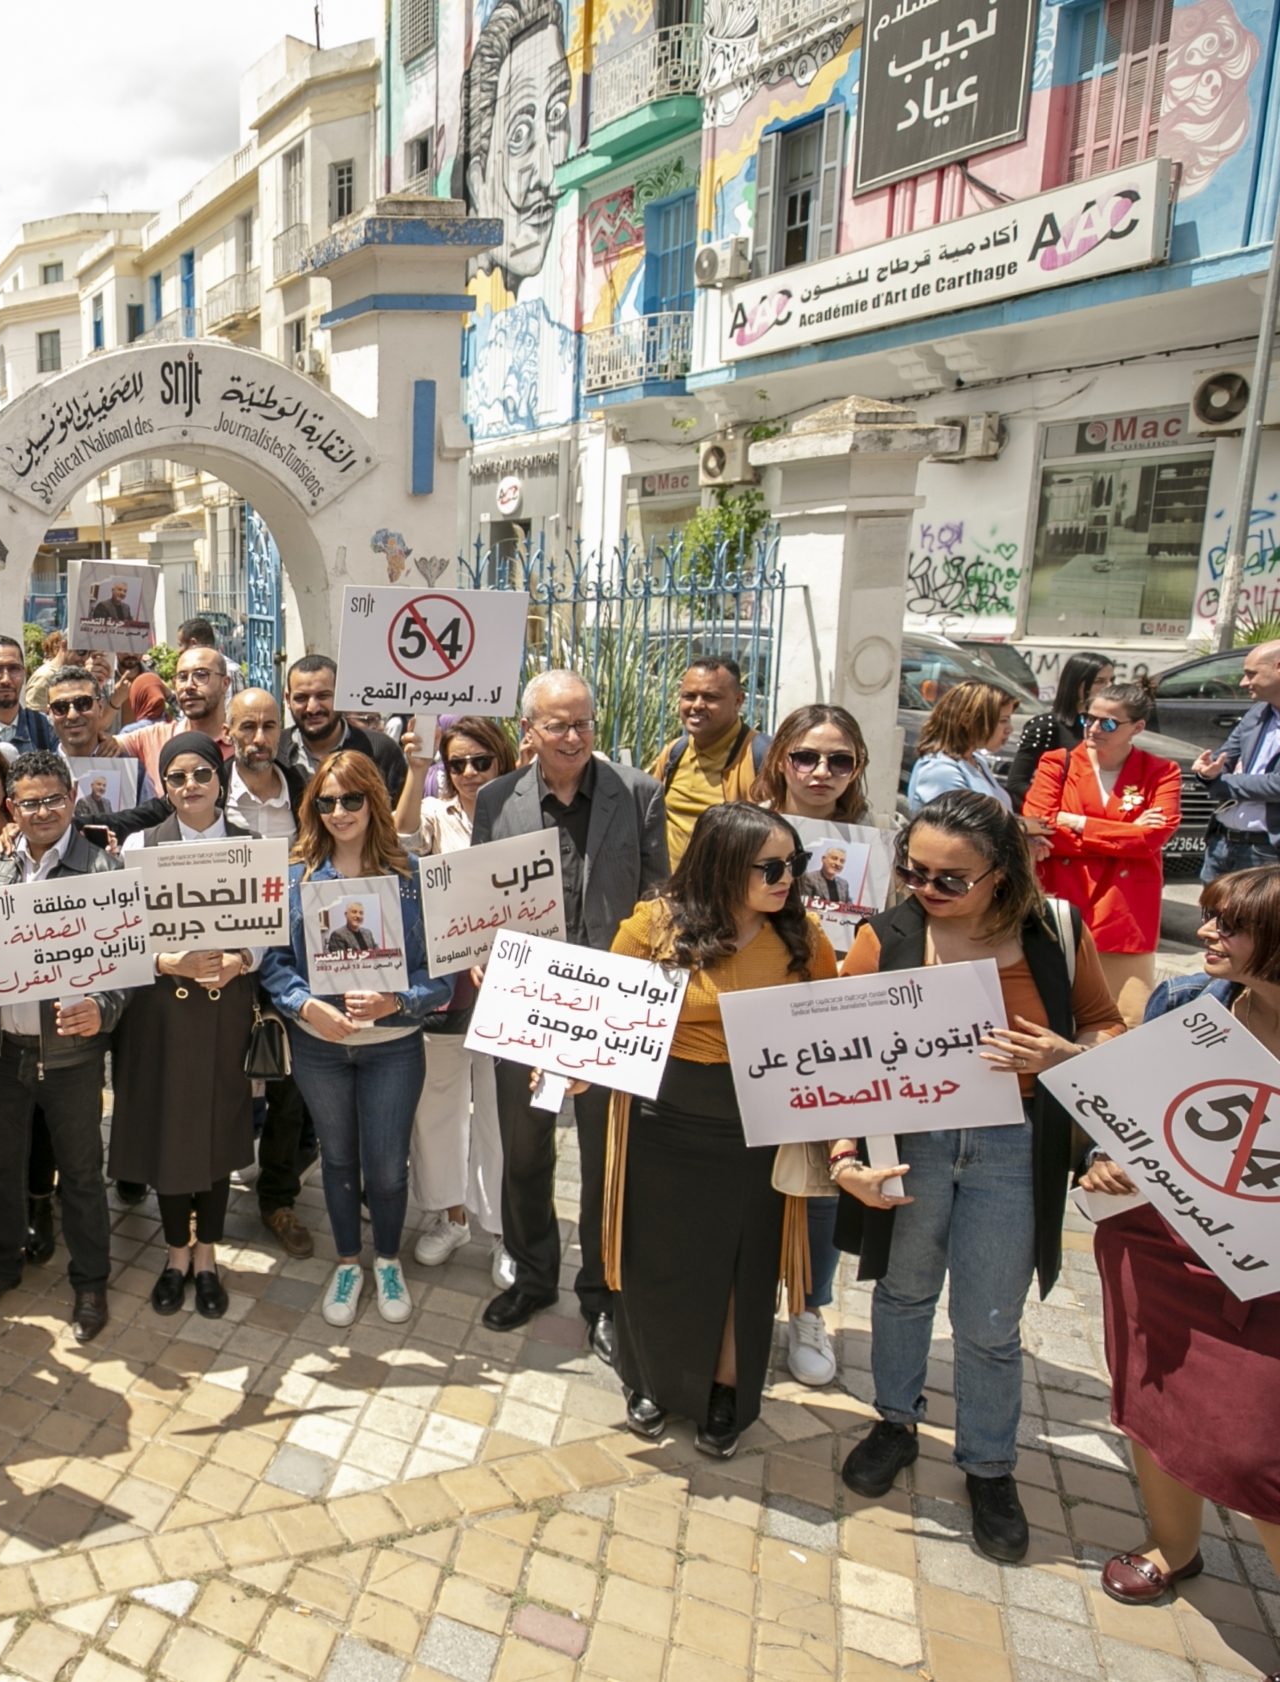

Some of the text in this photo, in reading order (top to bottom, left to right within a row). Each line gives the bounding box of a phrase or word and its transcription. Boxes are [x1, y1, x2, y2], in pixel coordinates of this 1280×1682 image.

[888, 0, 998, 84] نجيب
[897, 75, 979, 132] عياد
[877, 249, 931, 283] قرطاج
[799, 260, 1018, 328] Académie d'Art de Carthage
[800, 267, 869, 303] للفنون
[160, 350, 202, 418] snjt
[1112, 415, 1183, 442] Mac
[31, 411, 325, 500] Syndicat National des Journalistes Tunisiens
[658, 472, 689, 489] Mac
[350, 593, 376, 617] snjt
[398, 617, 463, 660] 54
[1156, 622, 1185, 634] Mac
[410, 685, 474, 707] لمرسوم
[228, 844, 253, 868] snjt
[1178, 837, 1207, 851] 3645
[426, 858, 452, 891] snjt
[491, 848, 555, 896] ضرب
[33, 881, 141, 915] أبواب مغلقة
[811, 895, 840, 913] حرية
[149, 907, 283, 941] ليست جريم
[541, 924, 560, 937] ضرب
[34, 936, 146, 965] زنازين موصدة
[436, 946, 472, 963] المعلومة
[497, 939, 533, 969] snjt
[547, 959, 679, 1005] أبواب مغلقة
[888, 978, 923, 1009] snjt
[474, 1022, 552, 1049] العقول
[527, 1008, 664, 1062] زنازين موصدة
[1182, 1012, 1233, 1048] snjt
[748, 1048, 788, 1080] على
[796, 1036, 873, 1076] الدفاع
[880, 1031, 908, 1072] في
[789, 1075, 961, 1110] حرية الصحافة
[1128, 1154, 1234, 1237] لمرسوم
